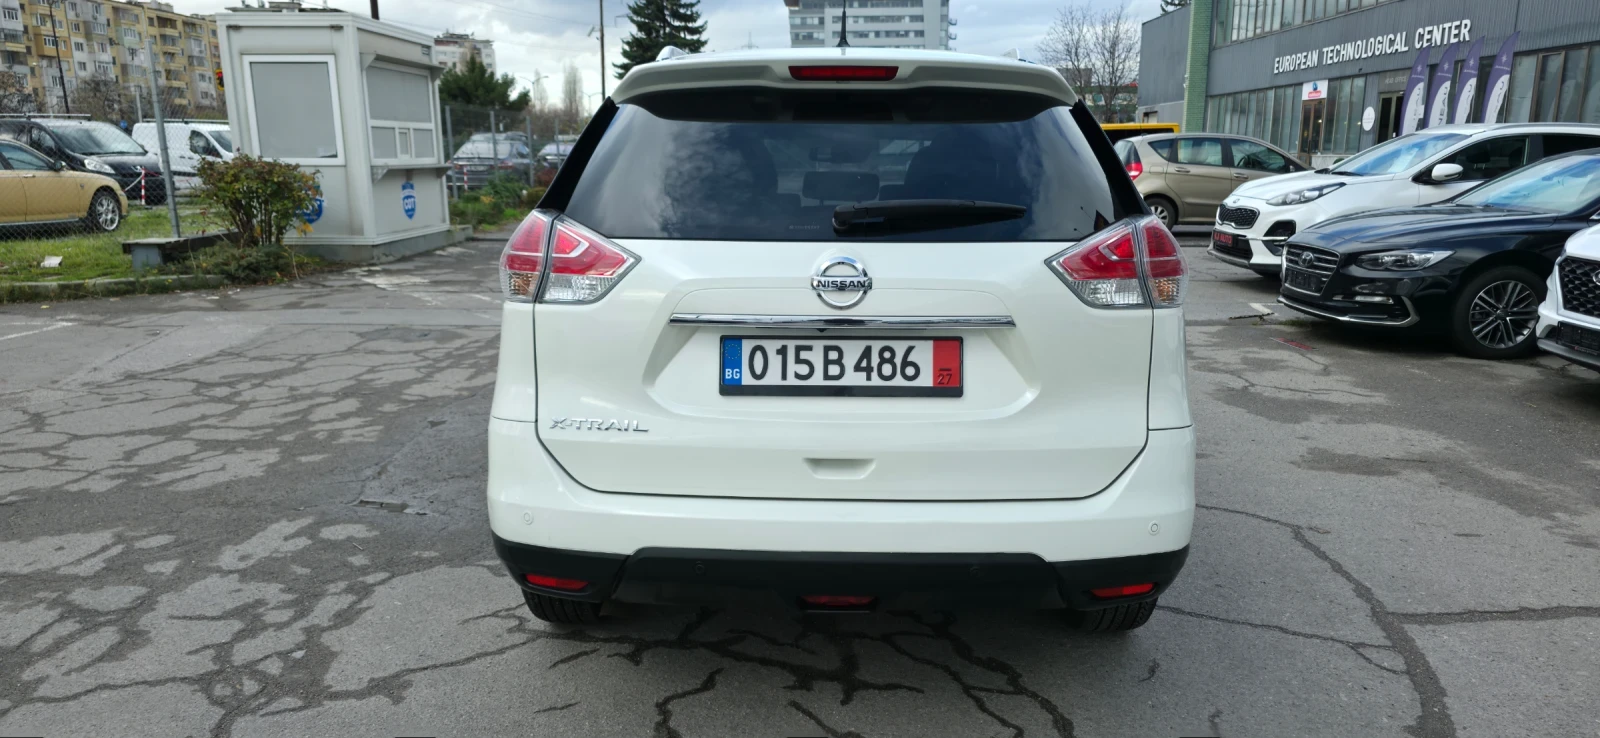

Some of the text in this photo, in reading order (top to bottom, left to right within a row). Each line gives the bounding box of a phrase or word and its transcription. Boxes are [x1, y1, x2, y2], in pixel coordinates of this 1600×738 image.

[1273, 19, 1471, 74] EUROPEAN TECHNOLOGICAL CENTER
[815, 280, 867, 289] NISSAN
[725, 368, 740, 379] BG
[937, 373, 953, 385] 27
[549, 416, 650, 432] X-TRAIL
